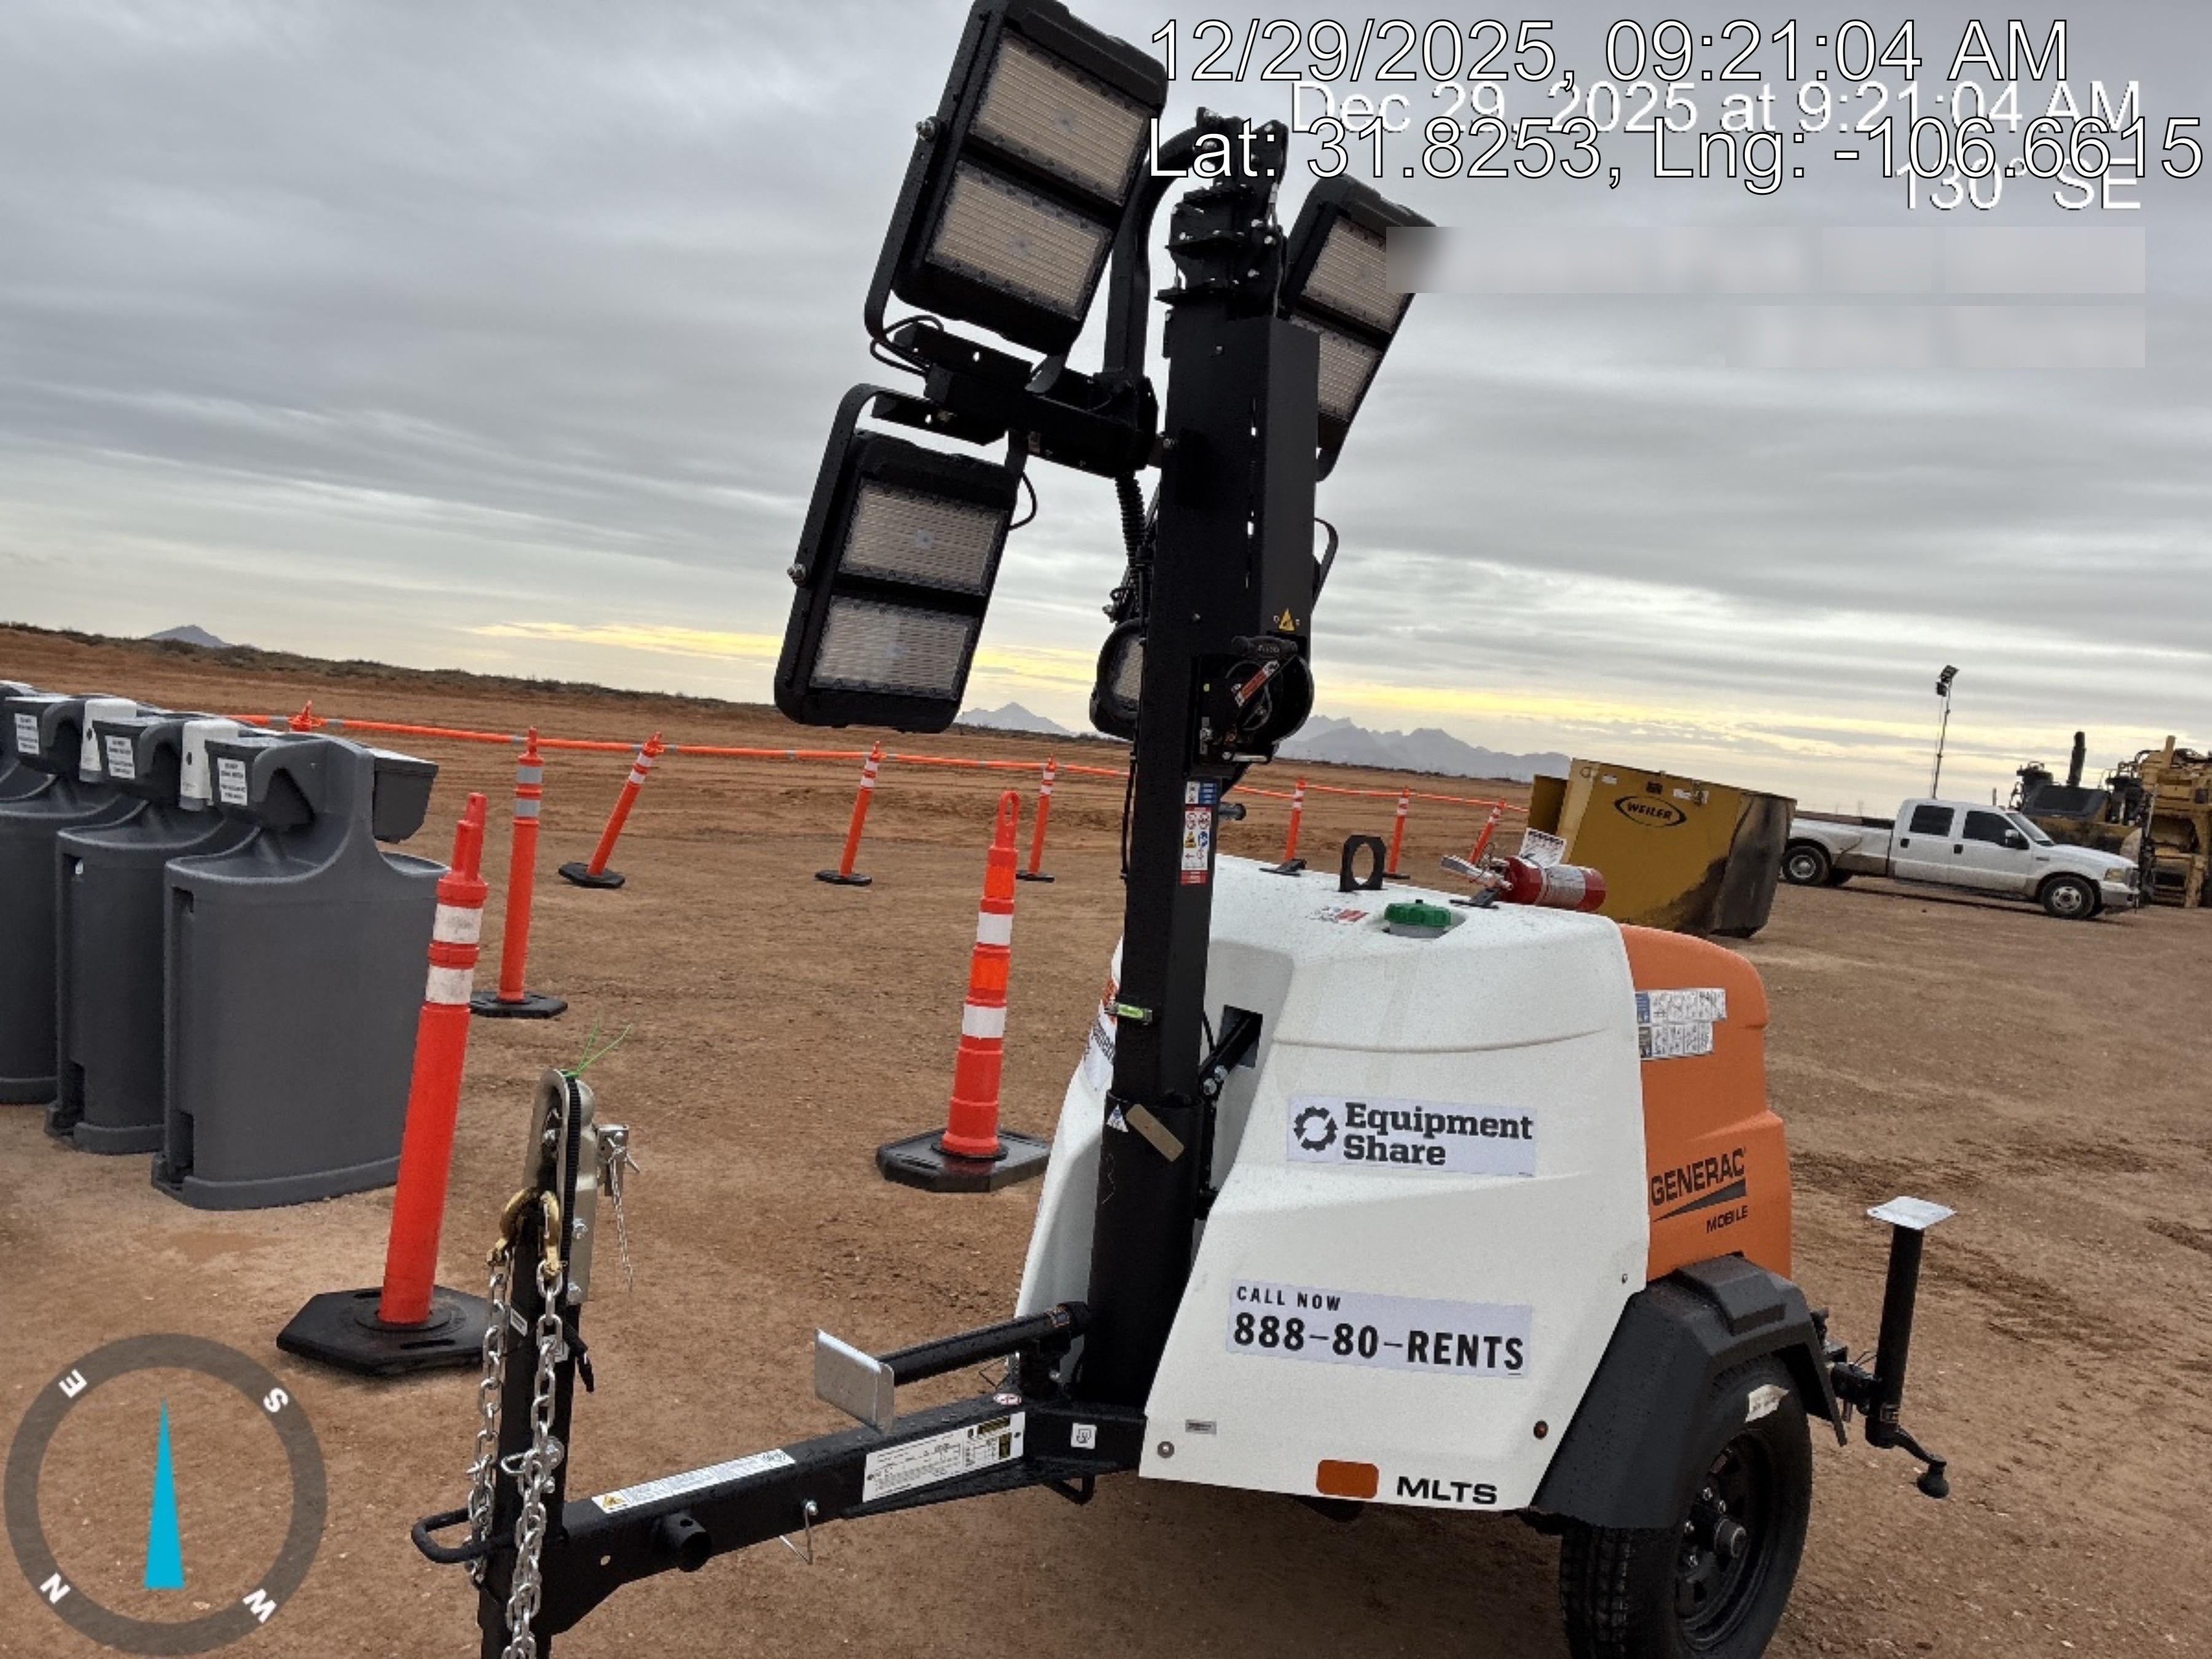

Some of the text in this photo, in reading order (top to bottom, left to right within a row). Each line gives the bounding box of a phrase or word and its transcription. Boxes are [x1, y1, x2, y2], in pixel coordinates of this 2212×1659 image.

[1345, 1102, 1534, 1140] Equipment
[1343, 1134, 1446, 1166] Share
[1650, 1147, 1746, 1206] GENERAC
[1706, 1204, 1749, 1234] MOBILE
[1236, 1286, 1341, 1311] CALL NOW
[1234, 1312, 1524, 1370] 888-80-RENTS
[1396, 1475, 1497, 1505] MLTS
